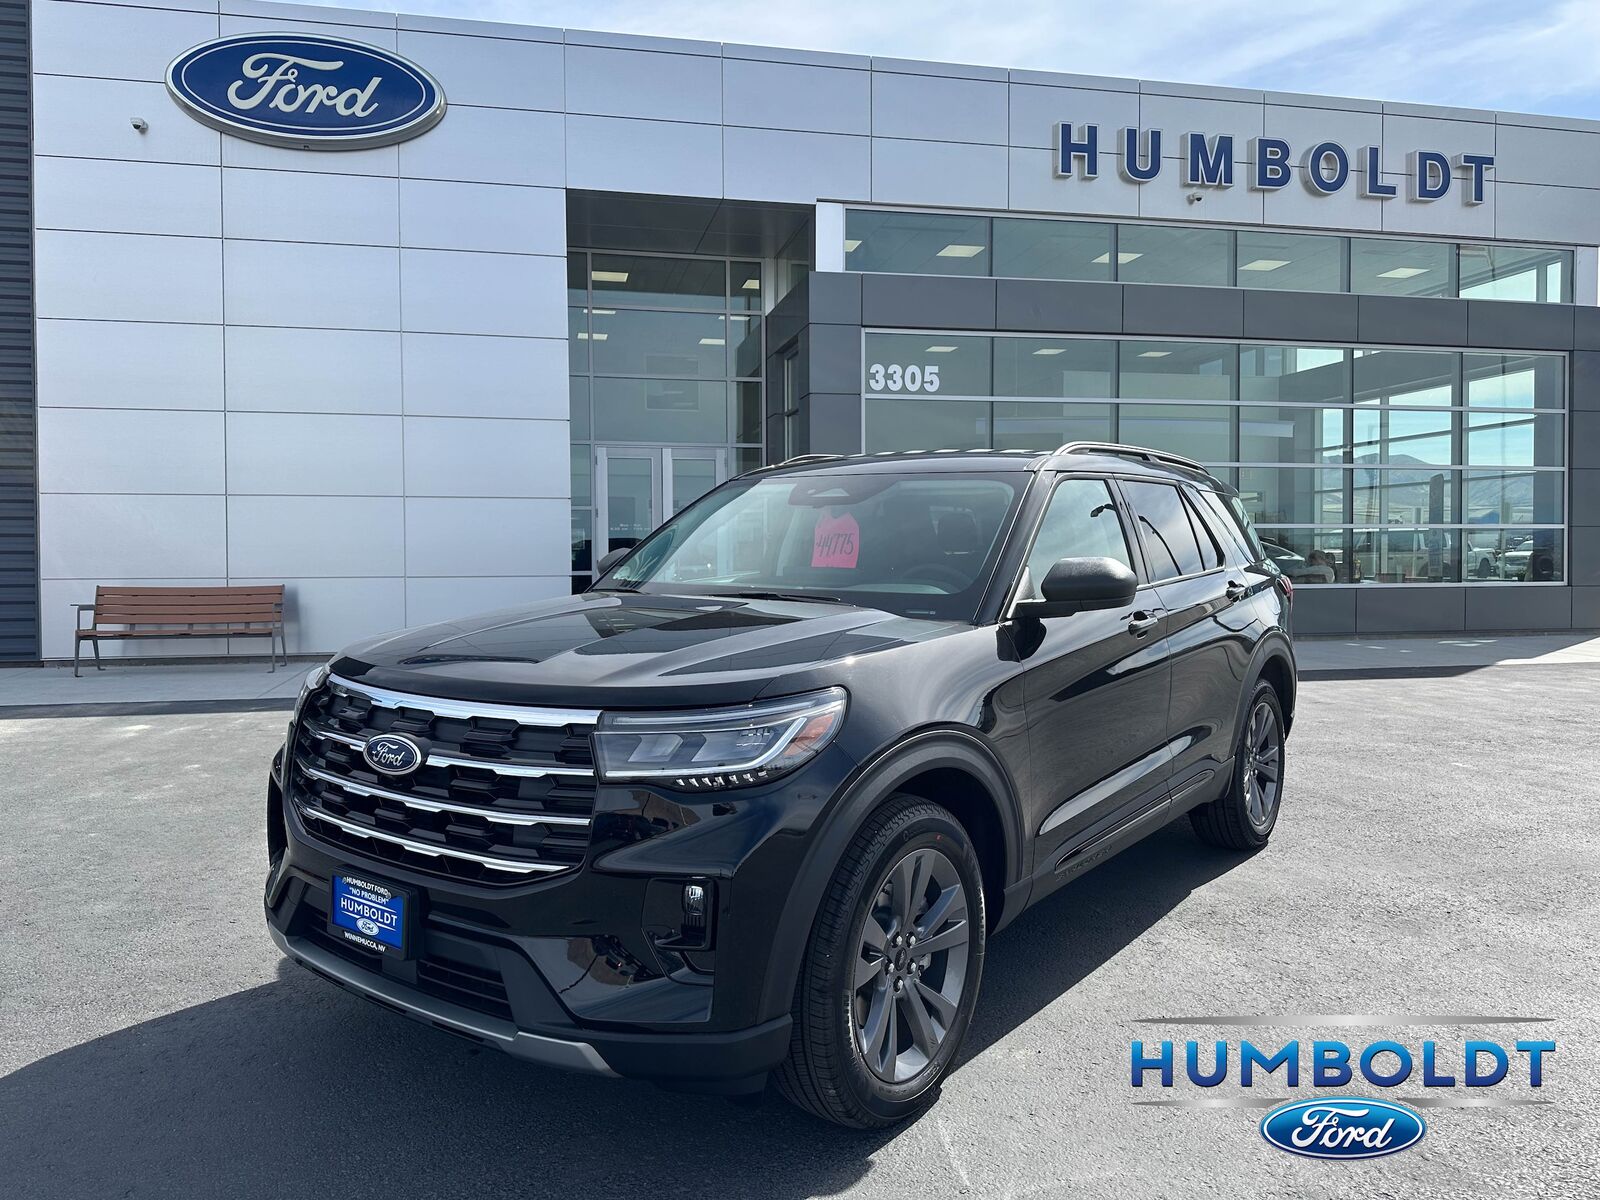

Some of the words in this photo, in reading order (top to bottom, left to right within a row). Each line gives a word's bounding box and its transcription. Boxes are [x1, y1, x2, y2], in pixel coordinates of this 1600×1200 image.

[227, 52, 382, 118] Ford
[1053, 120, 1496, 206] HUMBOLDT
[869, 363, 940, 392] 3305
[816, 533, 854, 557] 44775
[371, 741, 406, 767] Ford
[346, 876, 375, 891] HUMBOLDT
[374, 883, 389, 896] FORD
[340, 897, 398, 927] HUMBOLDT
